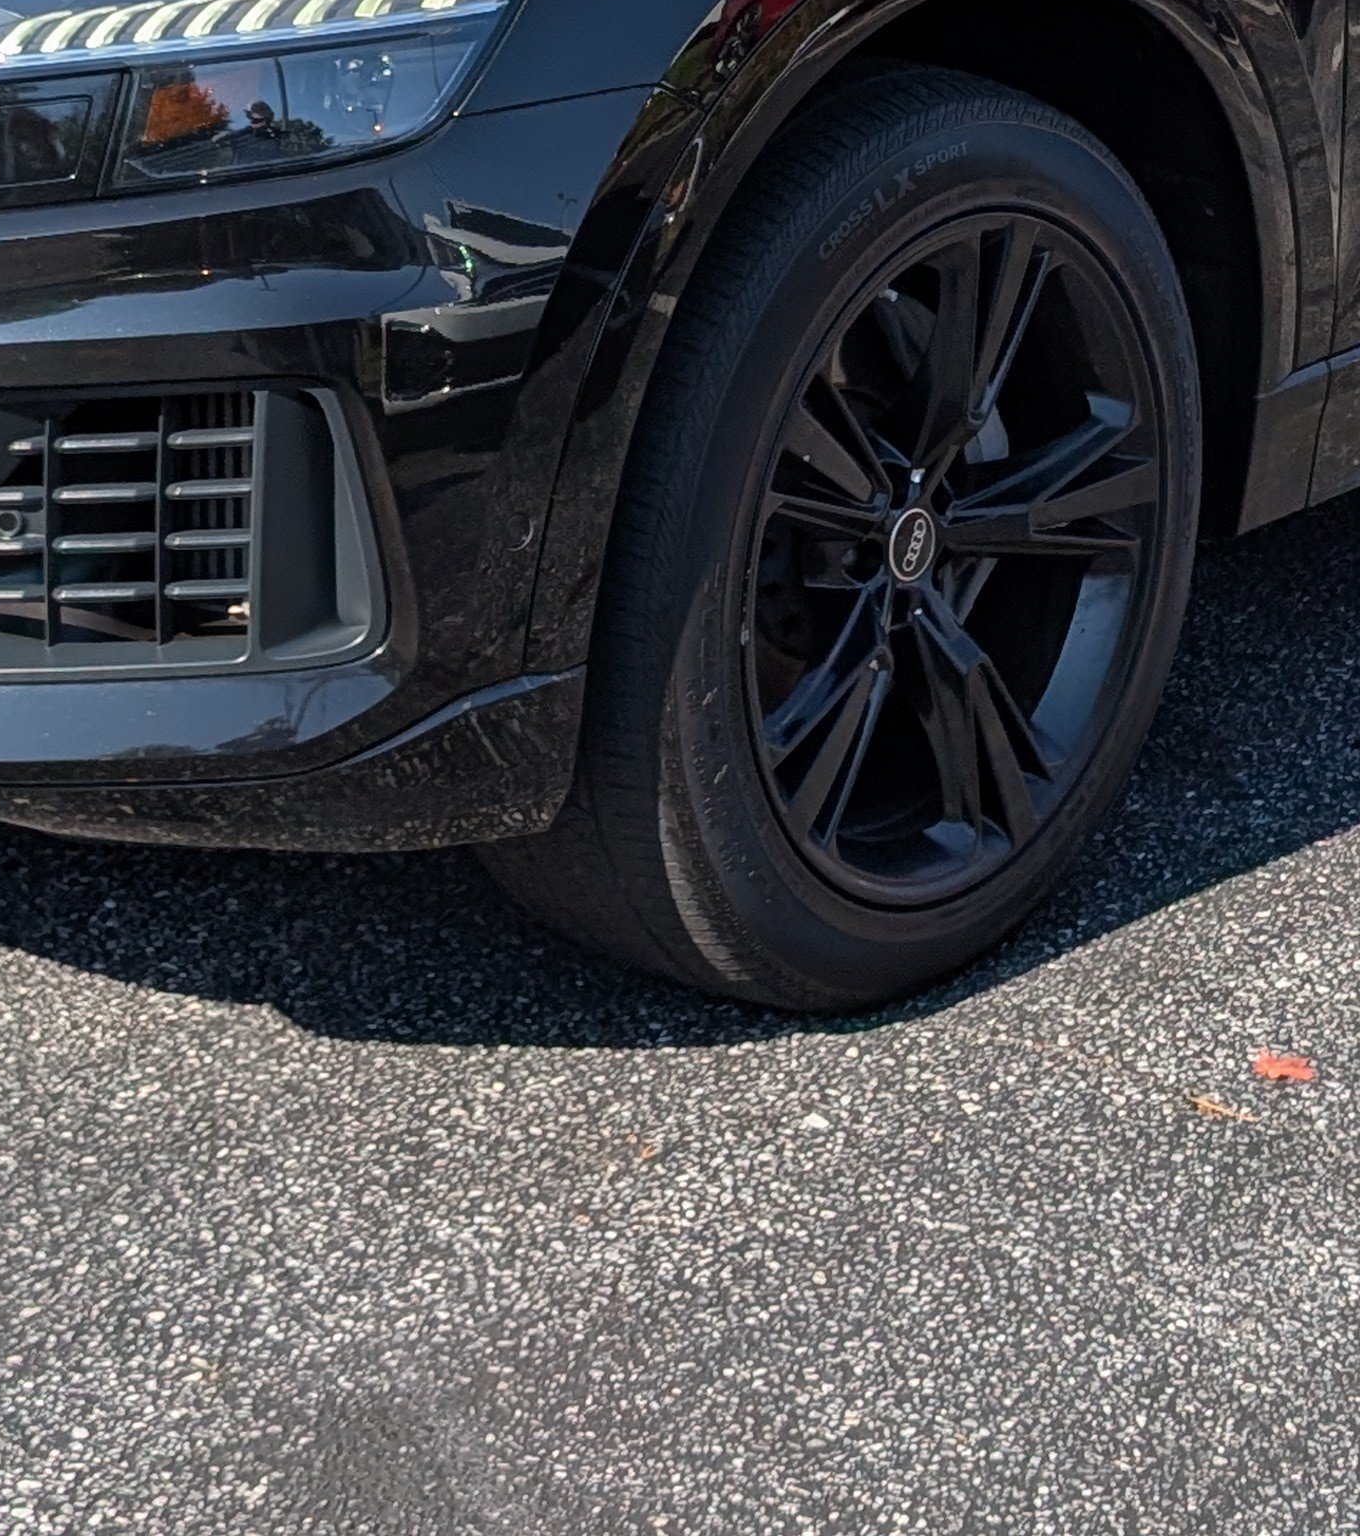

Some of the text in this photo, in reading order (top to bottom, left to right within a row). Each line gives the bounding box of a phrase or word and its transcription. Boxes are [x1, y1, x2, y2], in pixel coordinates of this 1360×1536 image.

[818, 198, 874, 261] CROSS
[874, 166, 918, 213] LX
[914, 140, 969, 176] SPORT
